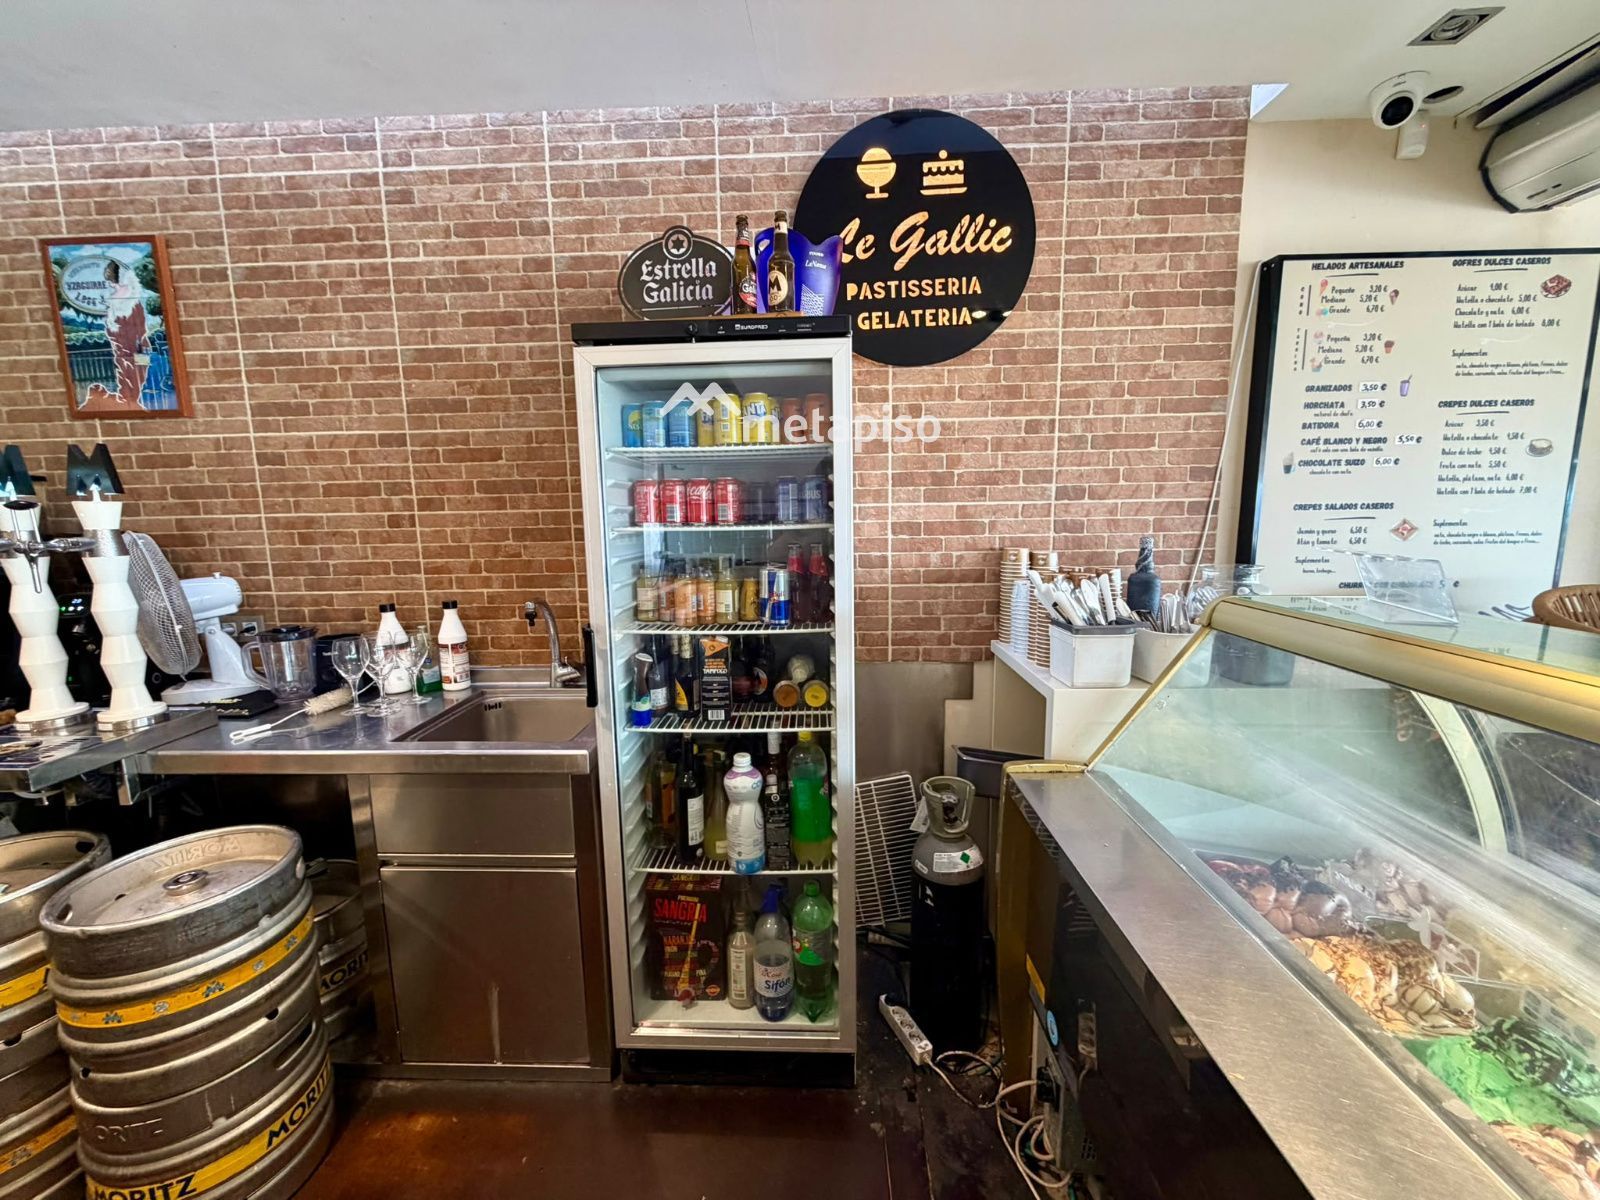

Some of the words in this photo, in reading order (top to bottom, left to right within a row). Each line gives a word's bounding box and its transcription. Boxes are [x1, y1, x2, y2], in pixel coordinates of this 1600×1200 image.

[839, 218, 875, 263] Le
[889, 211, 1012, 272] Gallic
[639, 258, 717, 281] Estrella
[1312, 262, 1346, 271] HELADOS
[1348, 261, 1404, 270] ARTESANALES
[642, 280, 714, 304] Galicia
[846, 276, 982, 300] PASTISSERIA
[857, 307, 972, 330] GELATERIA
[1305, 384, 1353, 392] GRANIZADOS
[1301, 436, 1320, 446] CAFÉ
[1298, 459, 1342, 467] CHOCOLATE
